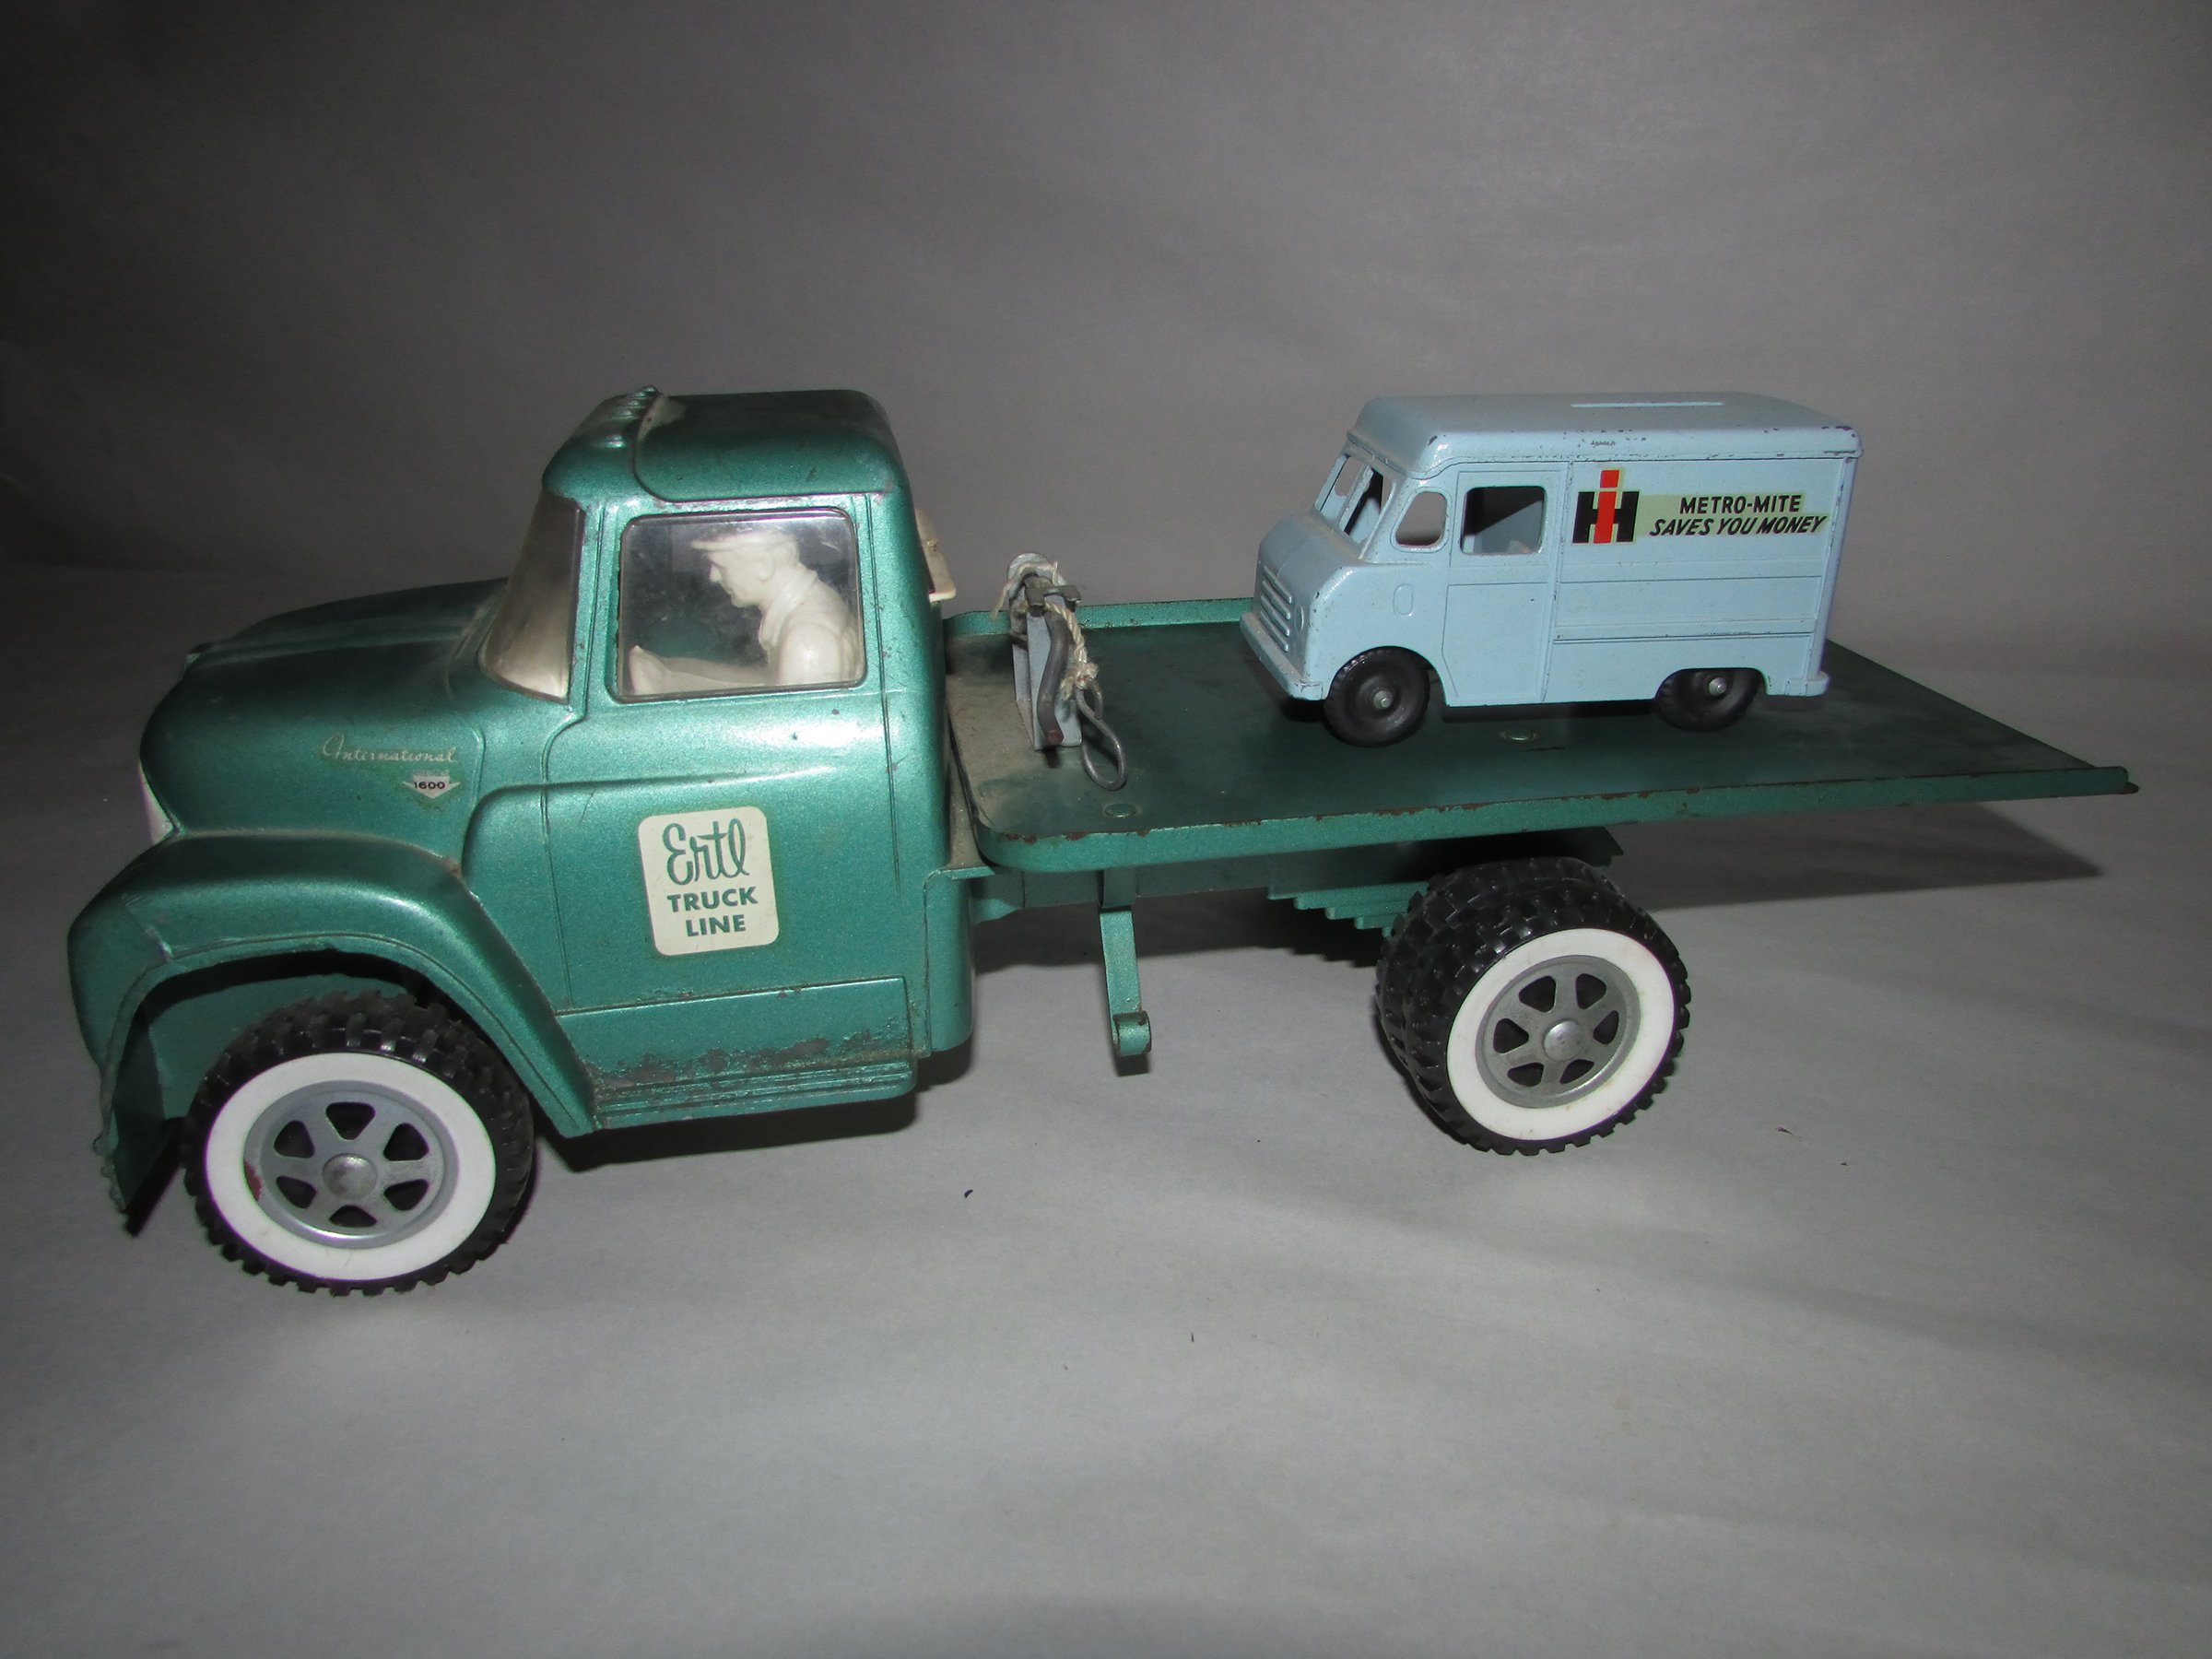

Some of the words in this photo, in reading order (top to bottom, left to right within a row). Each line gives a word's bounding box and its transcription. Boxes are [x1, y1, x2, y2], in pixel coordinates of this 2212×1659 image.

[1679, 494, 1802, 514] METRO-MITE
[1649, 518, 1713, 536] SAVES
[1718, 516, 1759, 535] YOU
[1756, 515, 1828, 535] MONEY
[414, 782, 446, 790] 1600
[662, 818, 750, 886] Ertl
[667, 887, 759, 912] TRUCK
[685, 914, 747, 937] LINE
